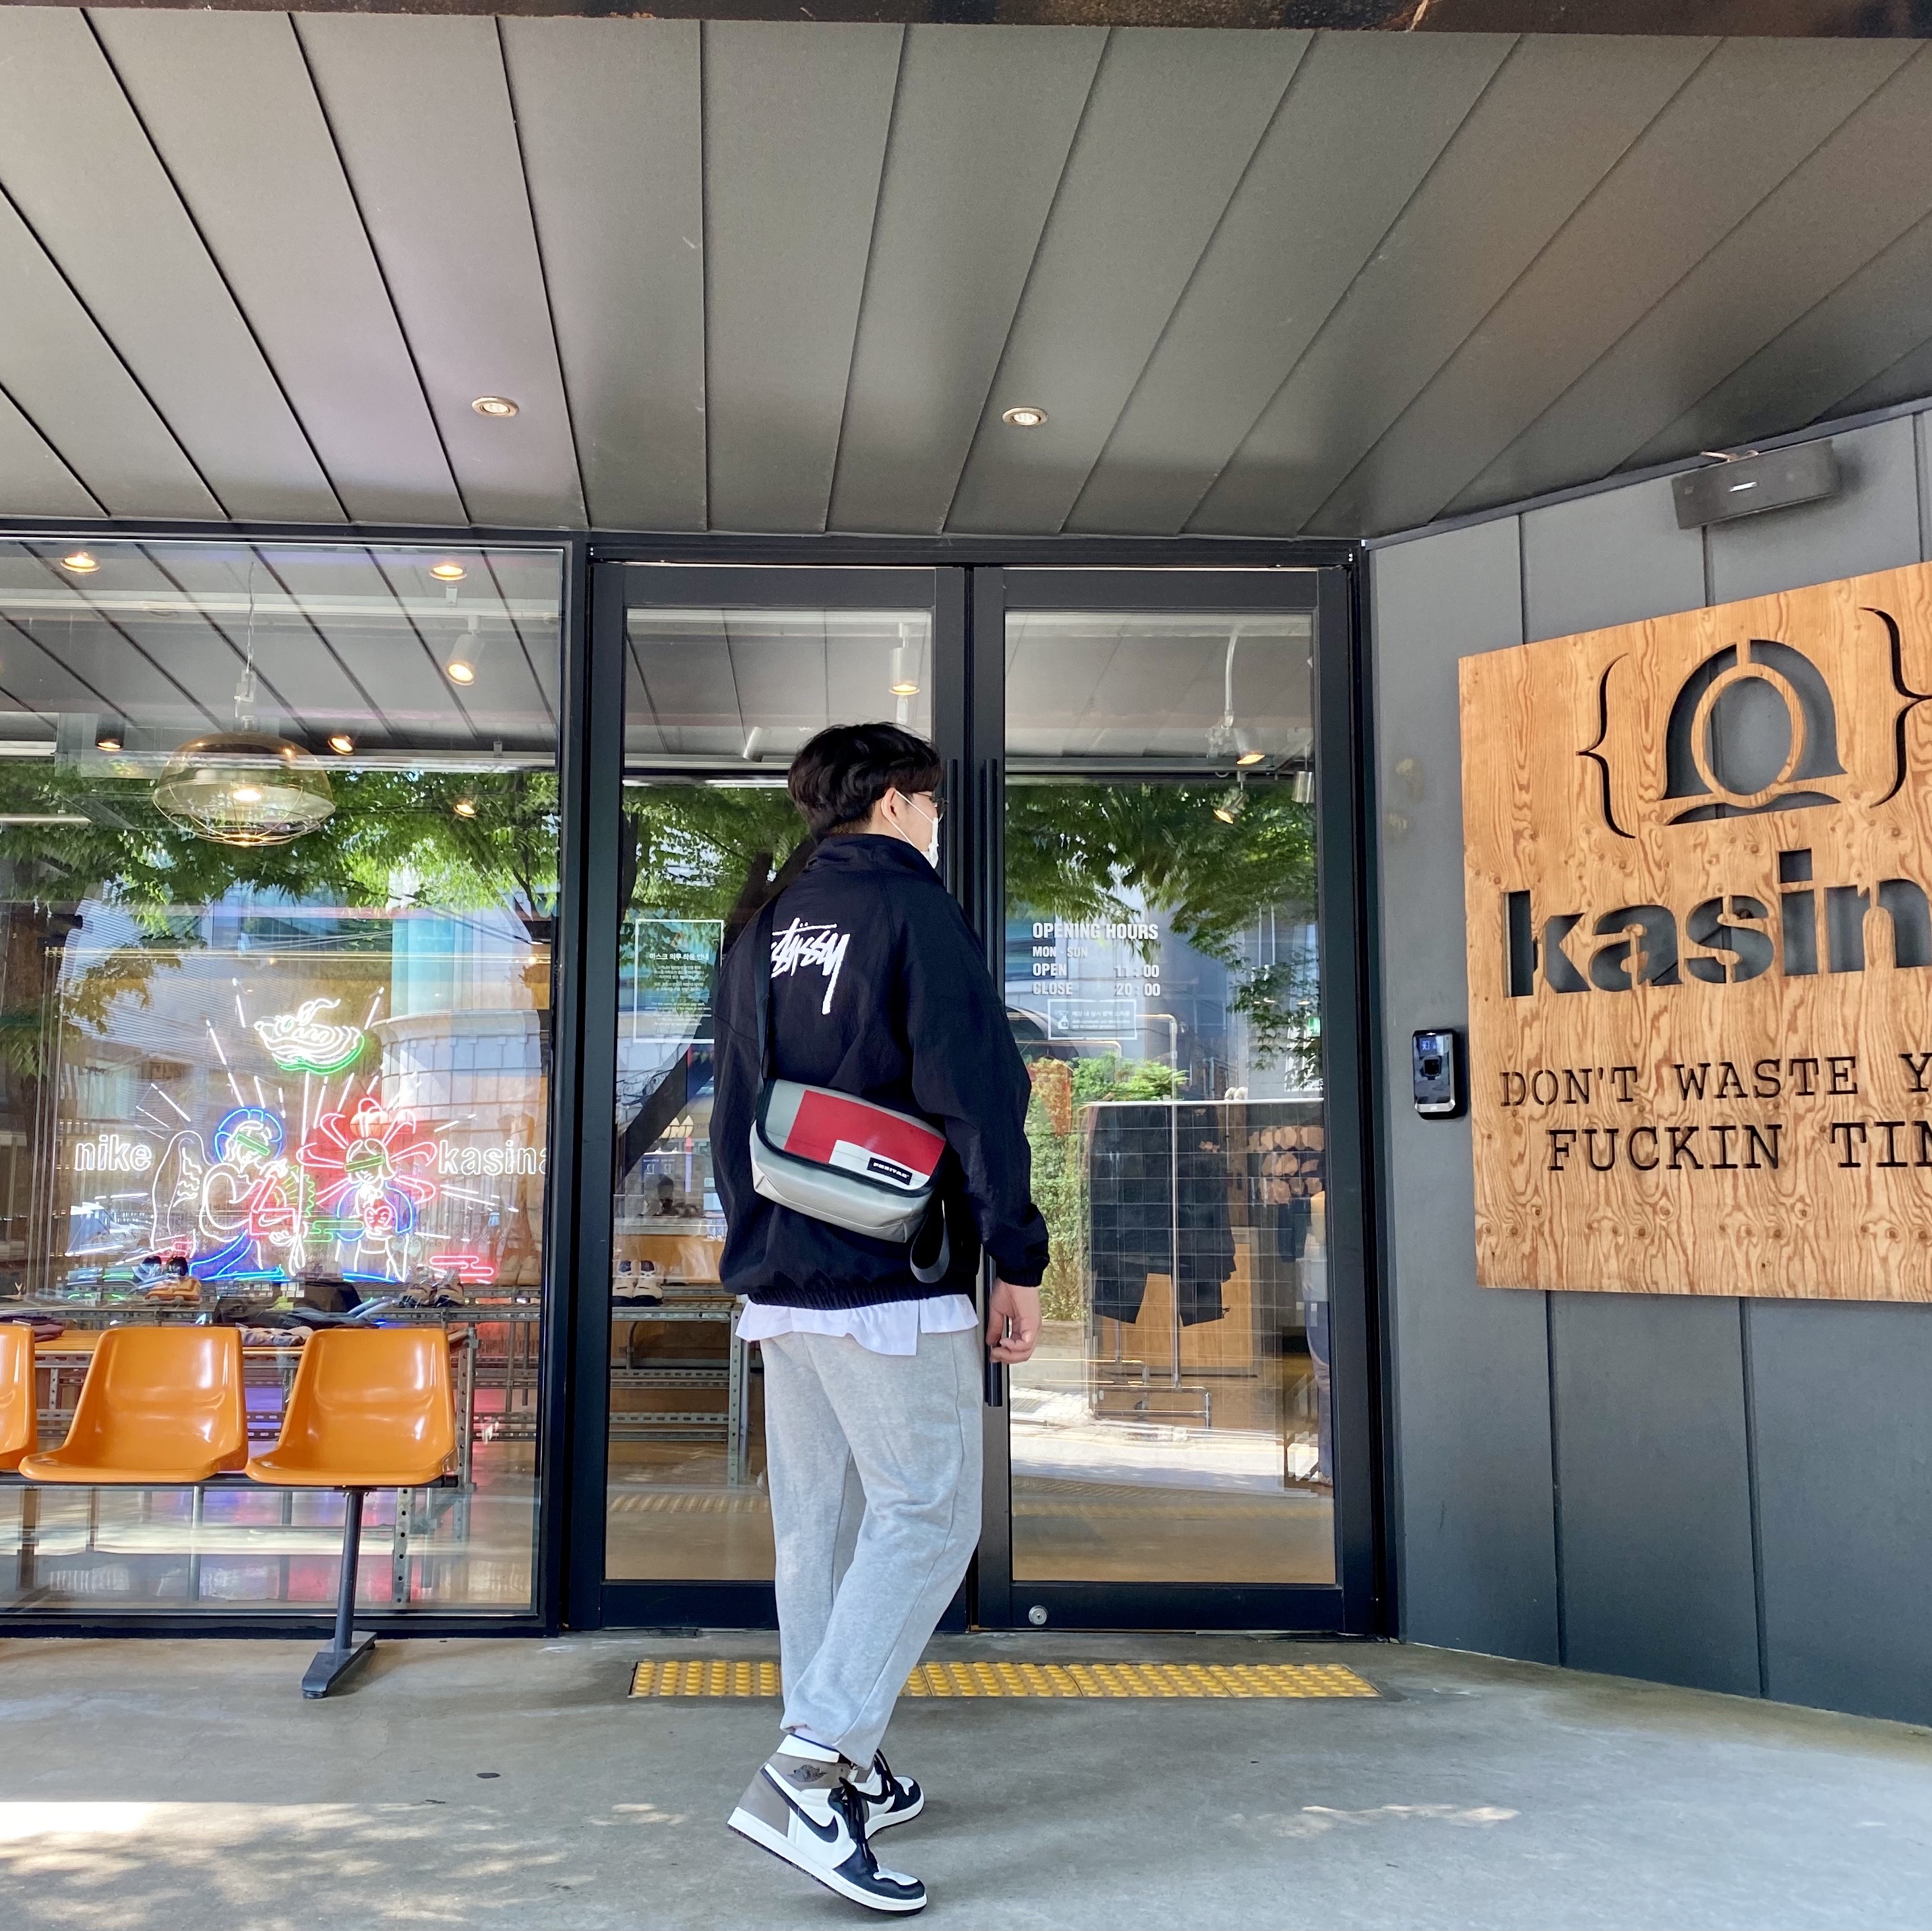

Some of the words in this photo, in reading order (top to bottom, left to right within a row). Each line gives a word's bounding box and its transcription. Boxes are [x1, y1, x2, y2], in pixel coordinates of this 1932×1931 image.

[1033, 922, 1101, 939] OPENING
[1106, 923, 1159, 939] HOURS
[1503, 848, 1932, 998] kasin
[1033, 946, 1056, 957] MON
[1067, 947, 1088, 958] SUN
[1033, 963, 1067, 976] OPEN
[1033, 982, 1073, 995] CLOSE
[1499, 1066, 1638, 1107] DON'T
[1671, 1056, 1857, 1100] WASTE
[75, 1134, 152, 1172] nike
[1546, 1124, 1782, 1171] FUCKIN
